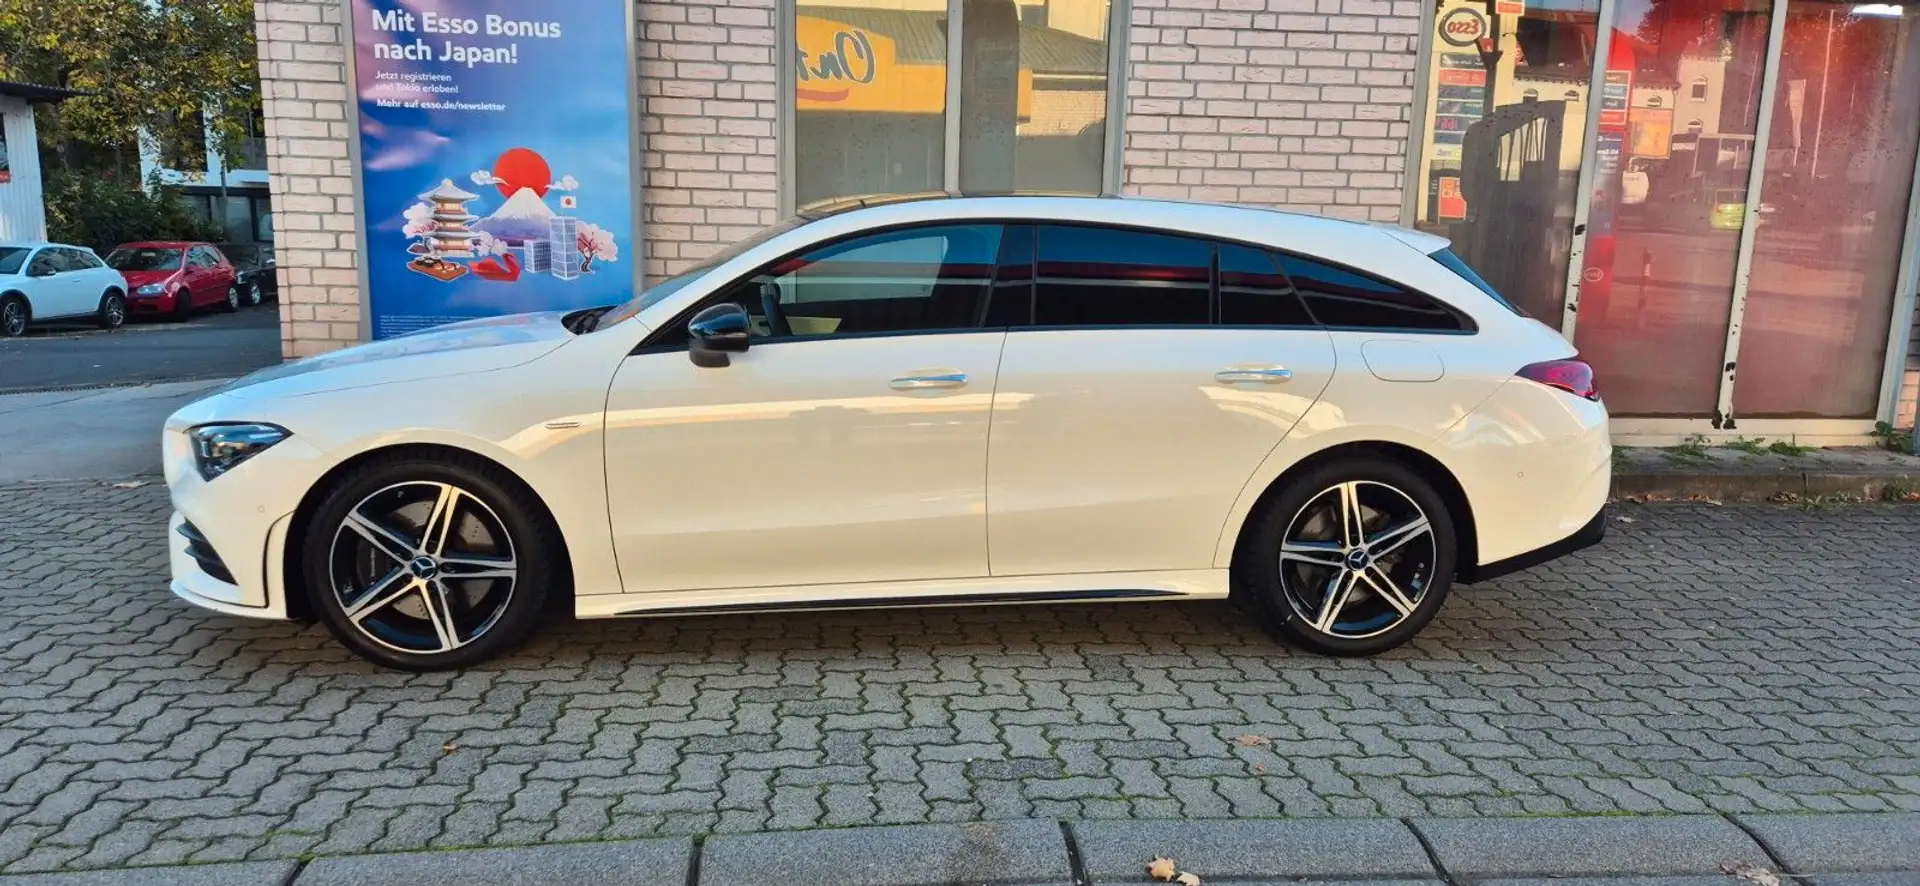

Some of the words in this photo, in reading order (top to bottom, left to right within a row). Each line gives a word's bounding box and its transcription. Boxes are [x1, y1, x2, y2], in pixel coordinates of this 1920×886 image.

[372, 9, 415, 32] Mit
[423, 12, 479, 35] Esso
[485, 14, 562, 38] Bonus
[374, 38, 432, 61] nach
[439, 41, 519, 68] Japan!
[375, 71, 399, 80] Jetzt
[401, 71, 452, 82] registrieren
[376, 83, 394, 91] und
[395, 82, 420, 92] Tokio
[422, 84, 459, 93] erleben!
[376, 98, 401, 108] Mehr
[404, 100, 418, 109] auf
[420, 101, 506, 111] esso.de/newsletter
